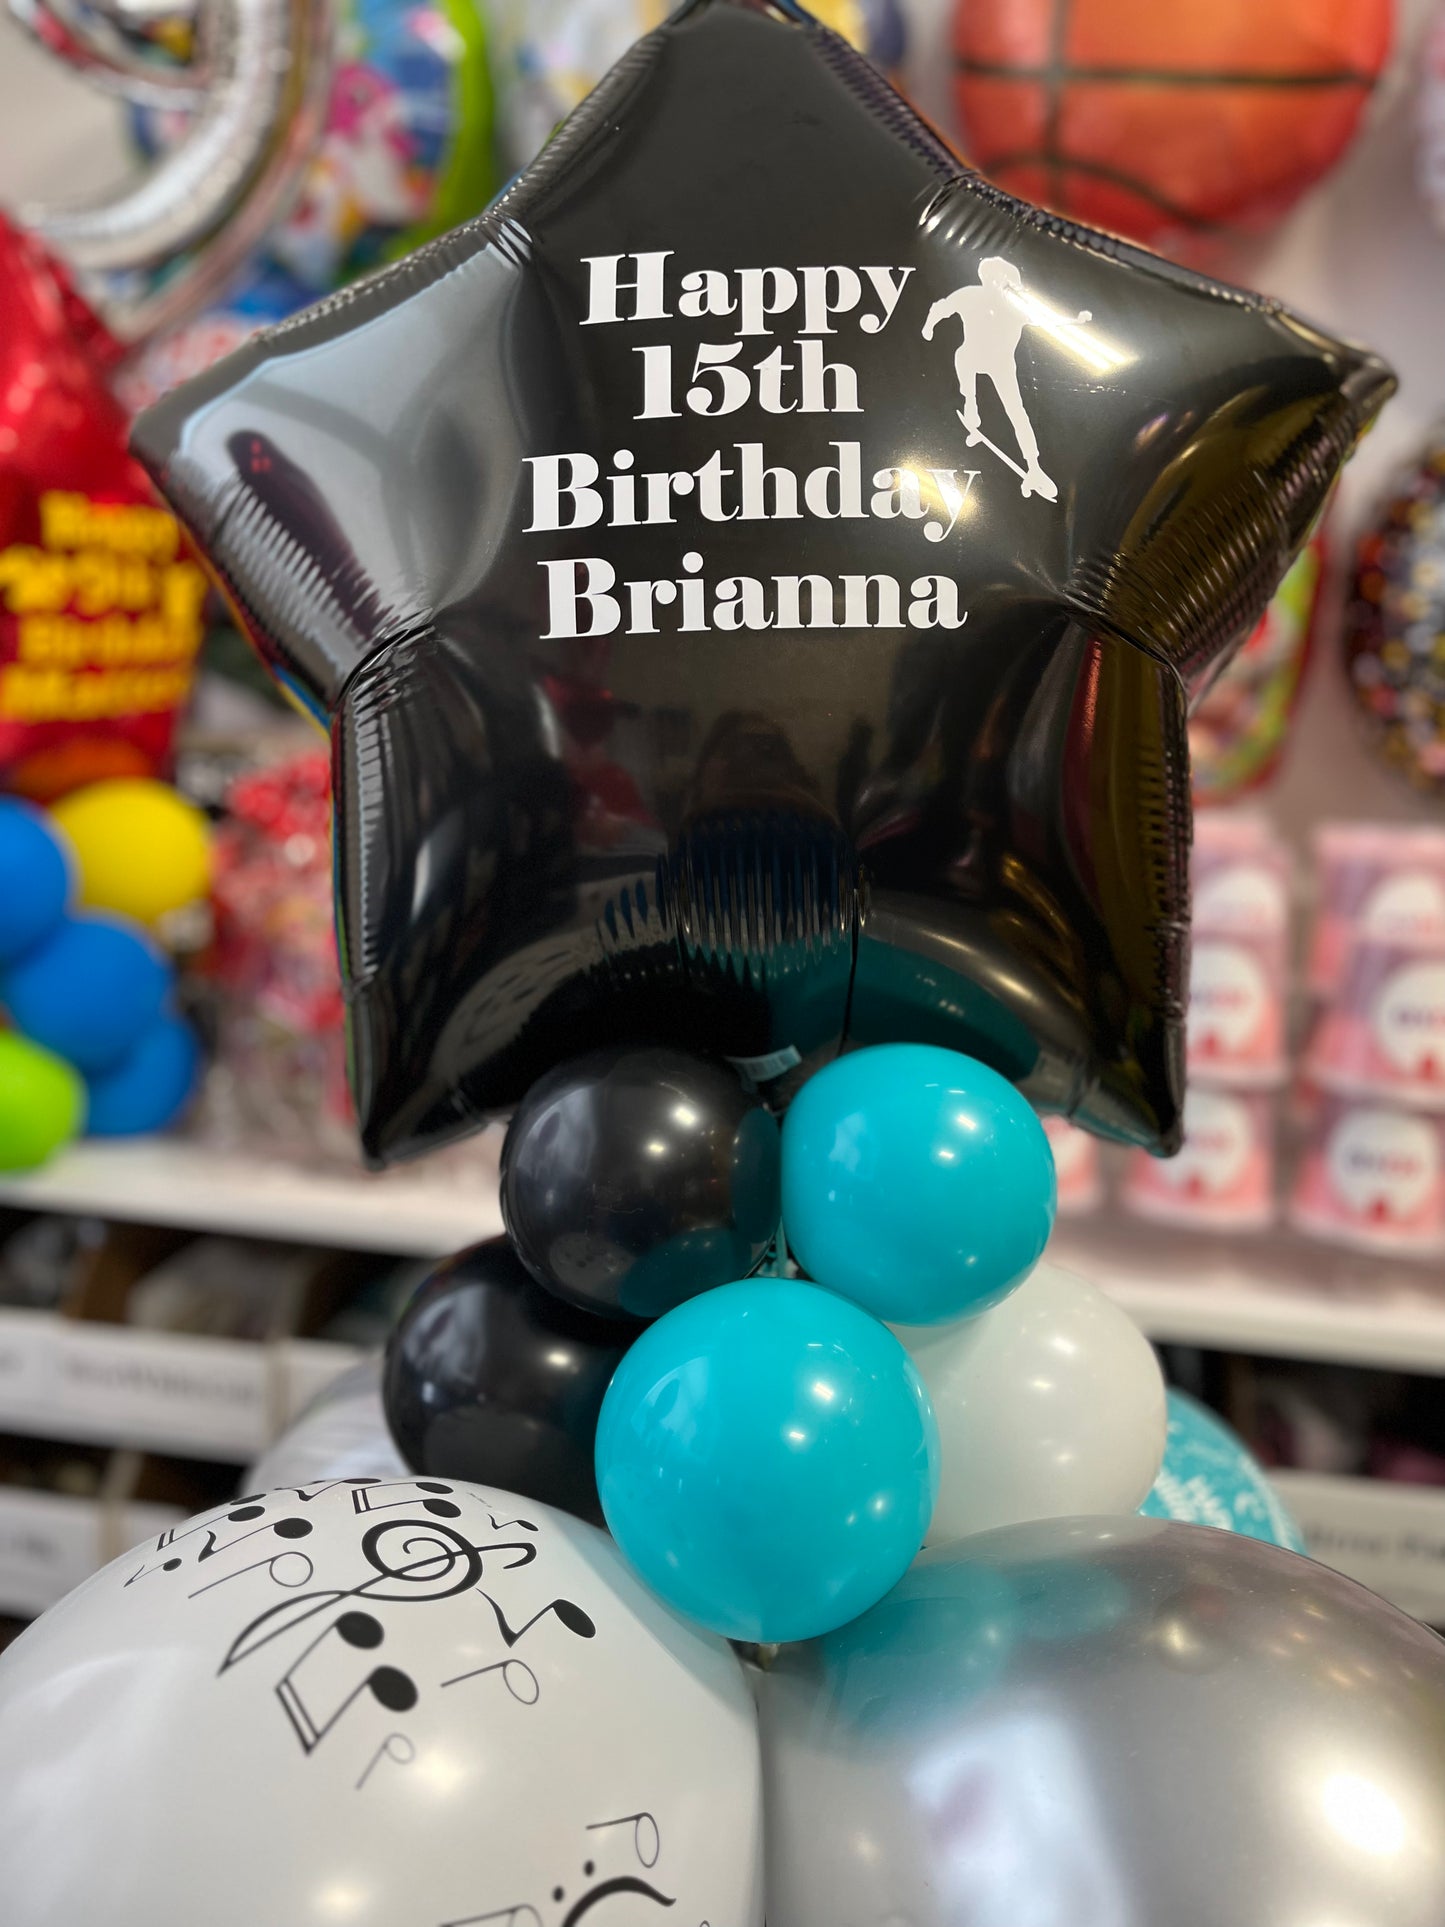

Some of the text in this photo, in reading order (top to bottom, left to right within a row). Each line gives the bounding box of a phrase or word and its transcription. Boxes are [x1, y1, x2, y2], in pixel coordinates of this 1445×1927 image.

[579, 250, 916, 335] Happy
[631, 340, 865, 420] 15th
[521, 441, 982, 543] Birthday
[536, 551, 968, 639] Brianna
